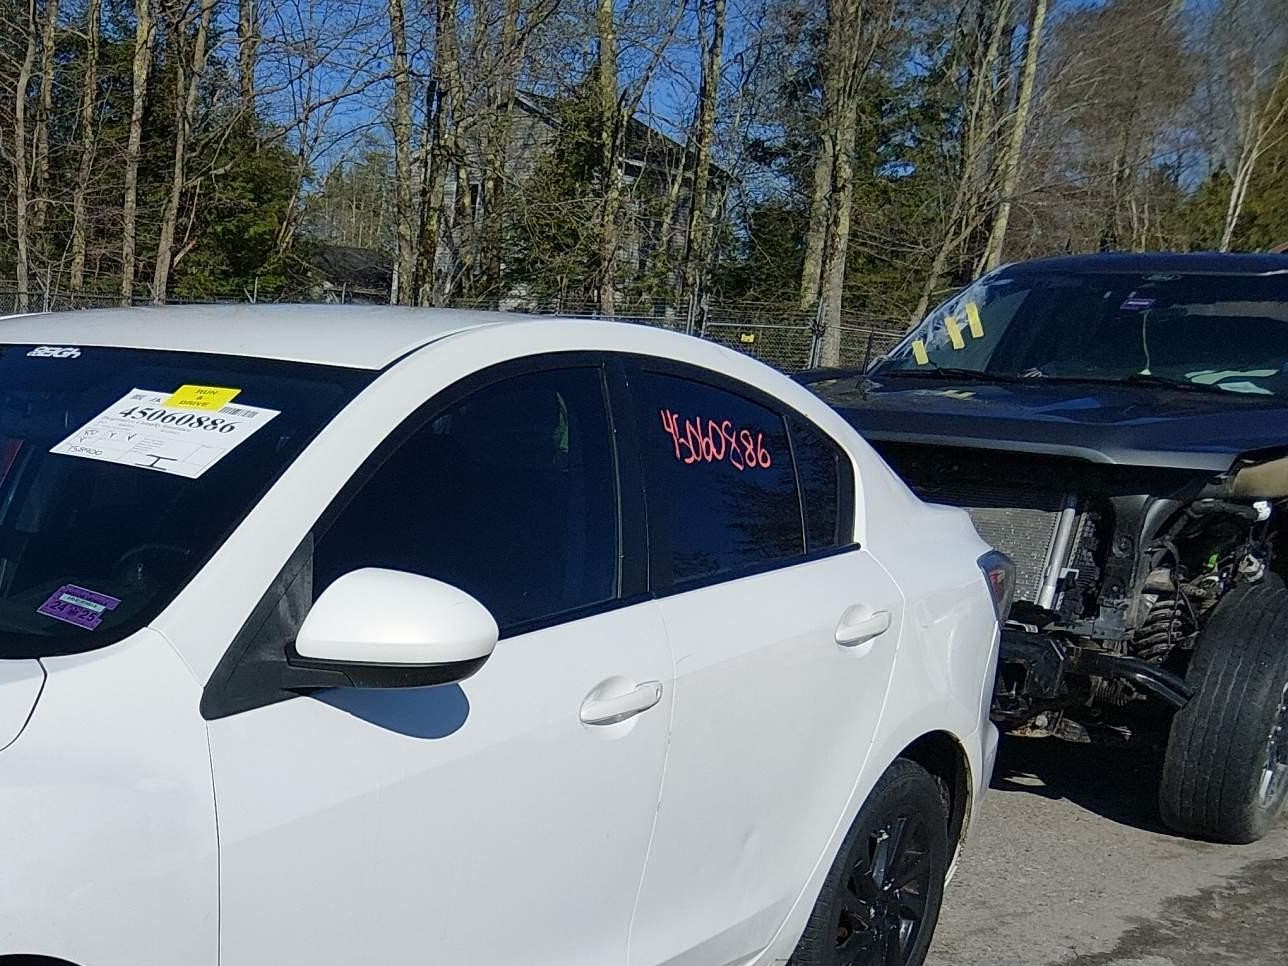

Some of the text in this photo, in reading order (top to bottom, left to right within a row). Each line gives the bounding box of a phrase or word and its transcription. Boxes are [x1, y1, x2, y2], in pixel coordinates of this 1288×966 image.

[119, 406, 242, 434] 45060886
[49, 600, 67, 612] 24
[78, 610, 97, 622] 25
